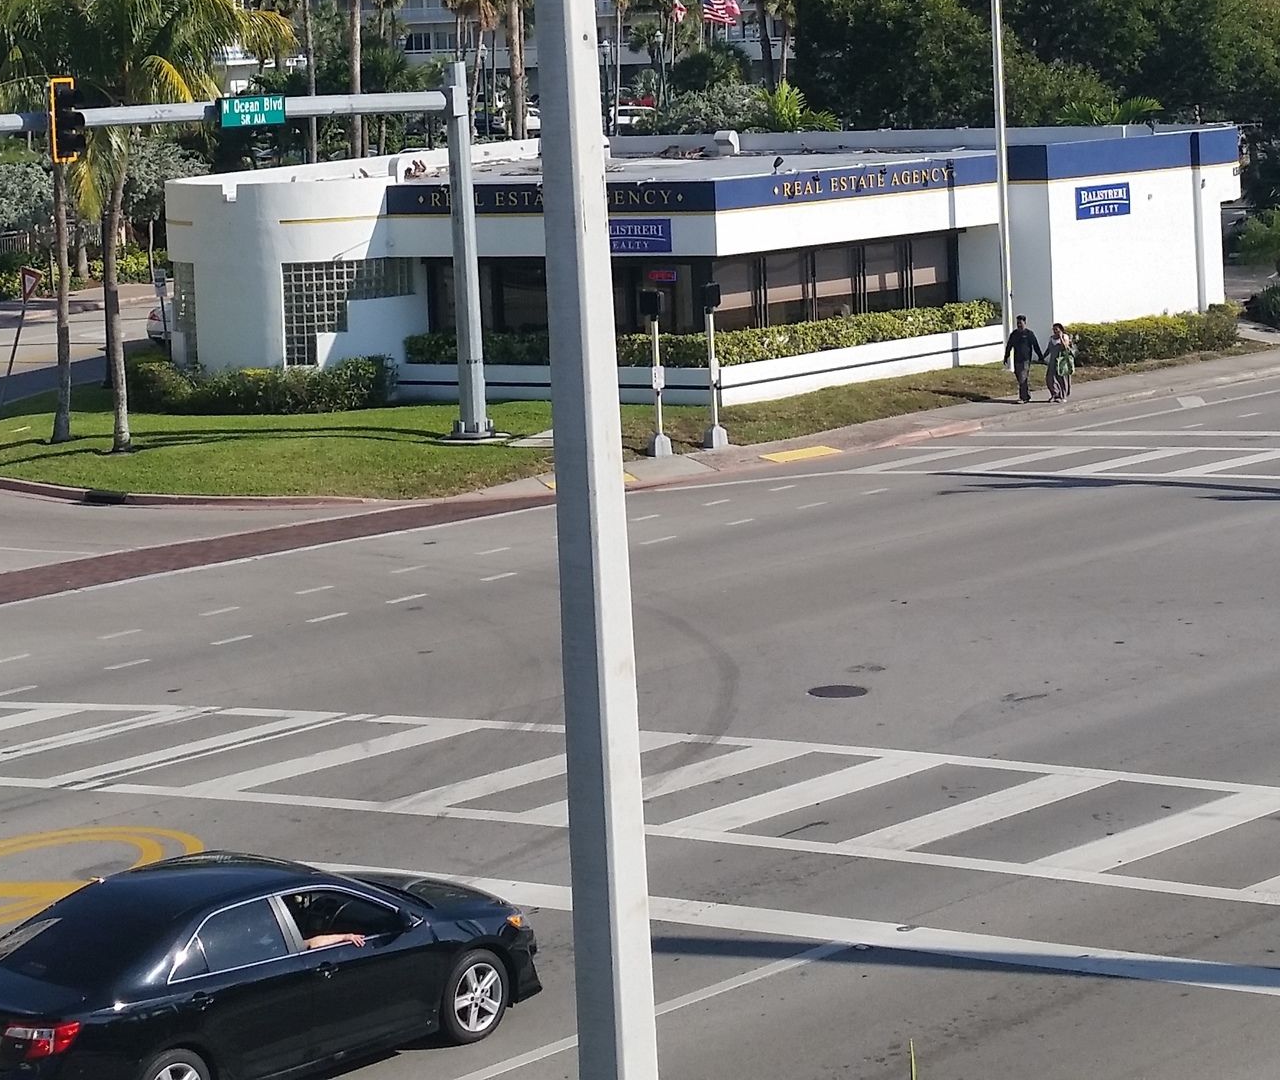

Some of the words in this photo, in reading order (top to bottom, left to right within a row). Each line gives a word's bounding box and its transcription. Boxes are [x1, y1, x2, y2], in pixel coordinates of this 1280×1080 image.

[223, 100, 229, 114] N
[234, 99, 259, 113] Ocean
[263, 97, 282, 111] Blvd
[241, 114, 251, 125] SR
[783, 181, 823, 197] REAL
[830, 174, 885, 192] ESTATE
[891, 167, 949, 186] AGENCY
[431, 192, 484, 206] REL
[495, 191, 543, 206] ESTA
[607, 190, 672, 205] ENCY
[1081, 187, 1127, 203] BALISTRERI
[1090, 204, 1119, 215] REALTY
[609, 224, 663, 236] LISTRERI
[612, 240, 649, 250] EALTY
